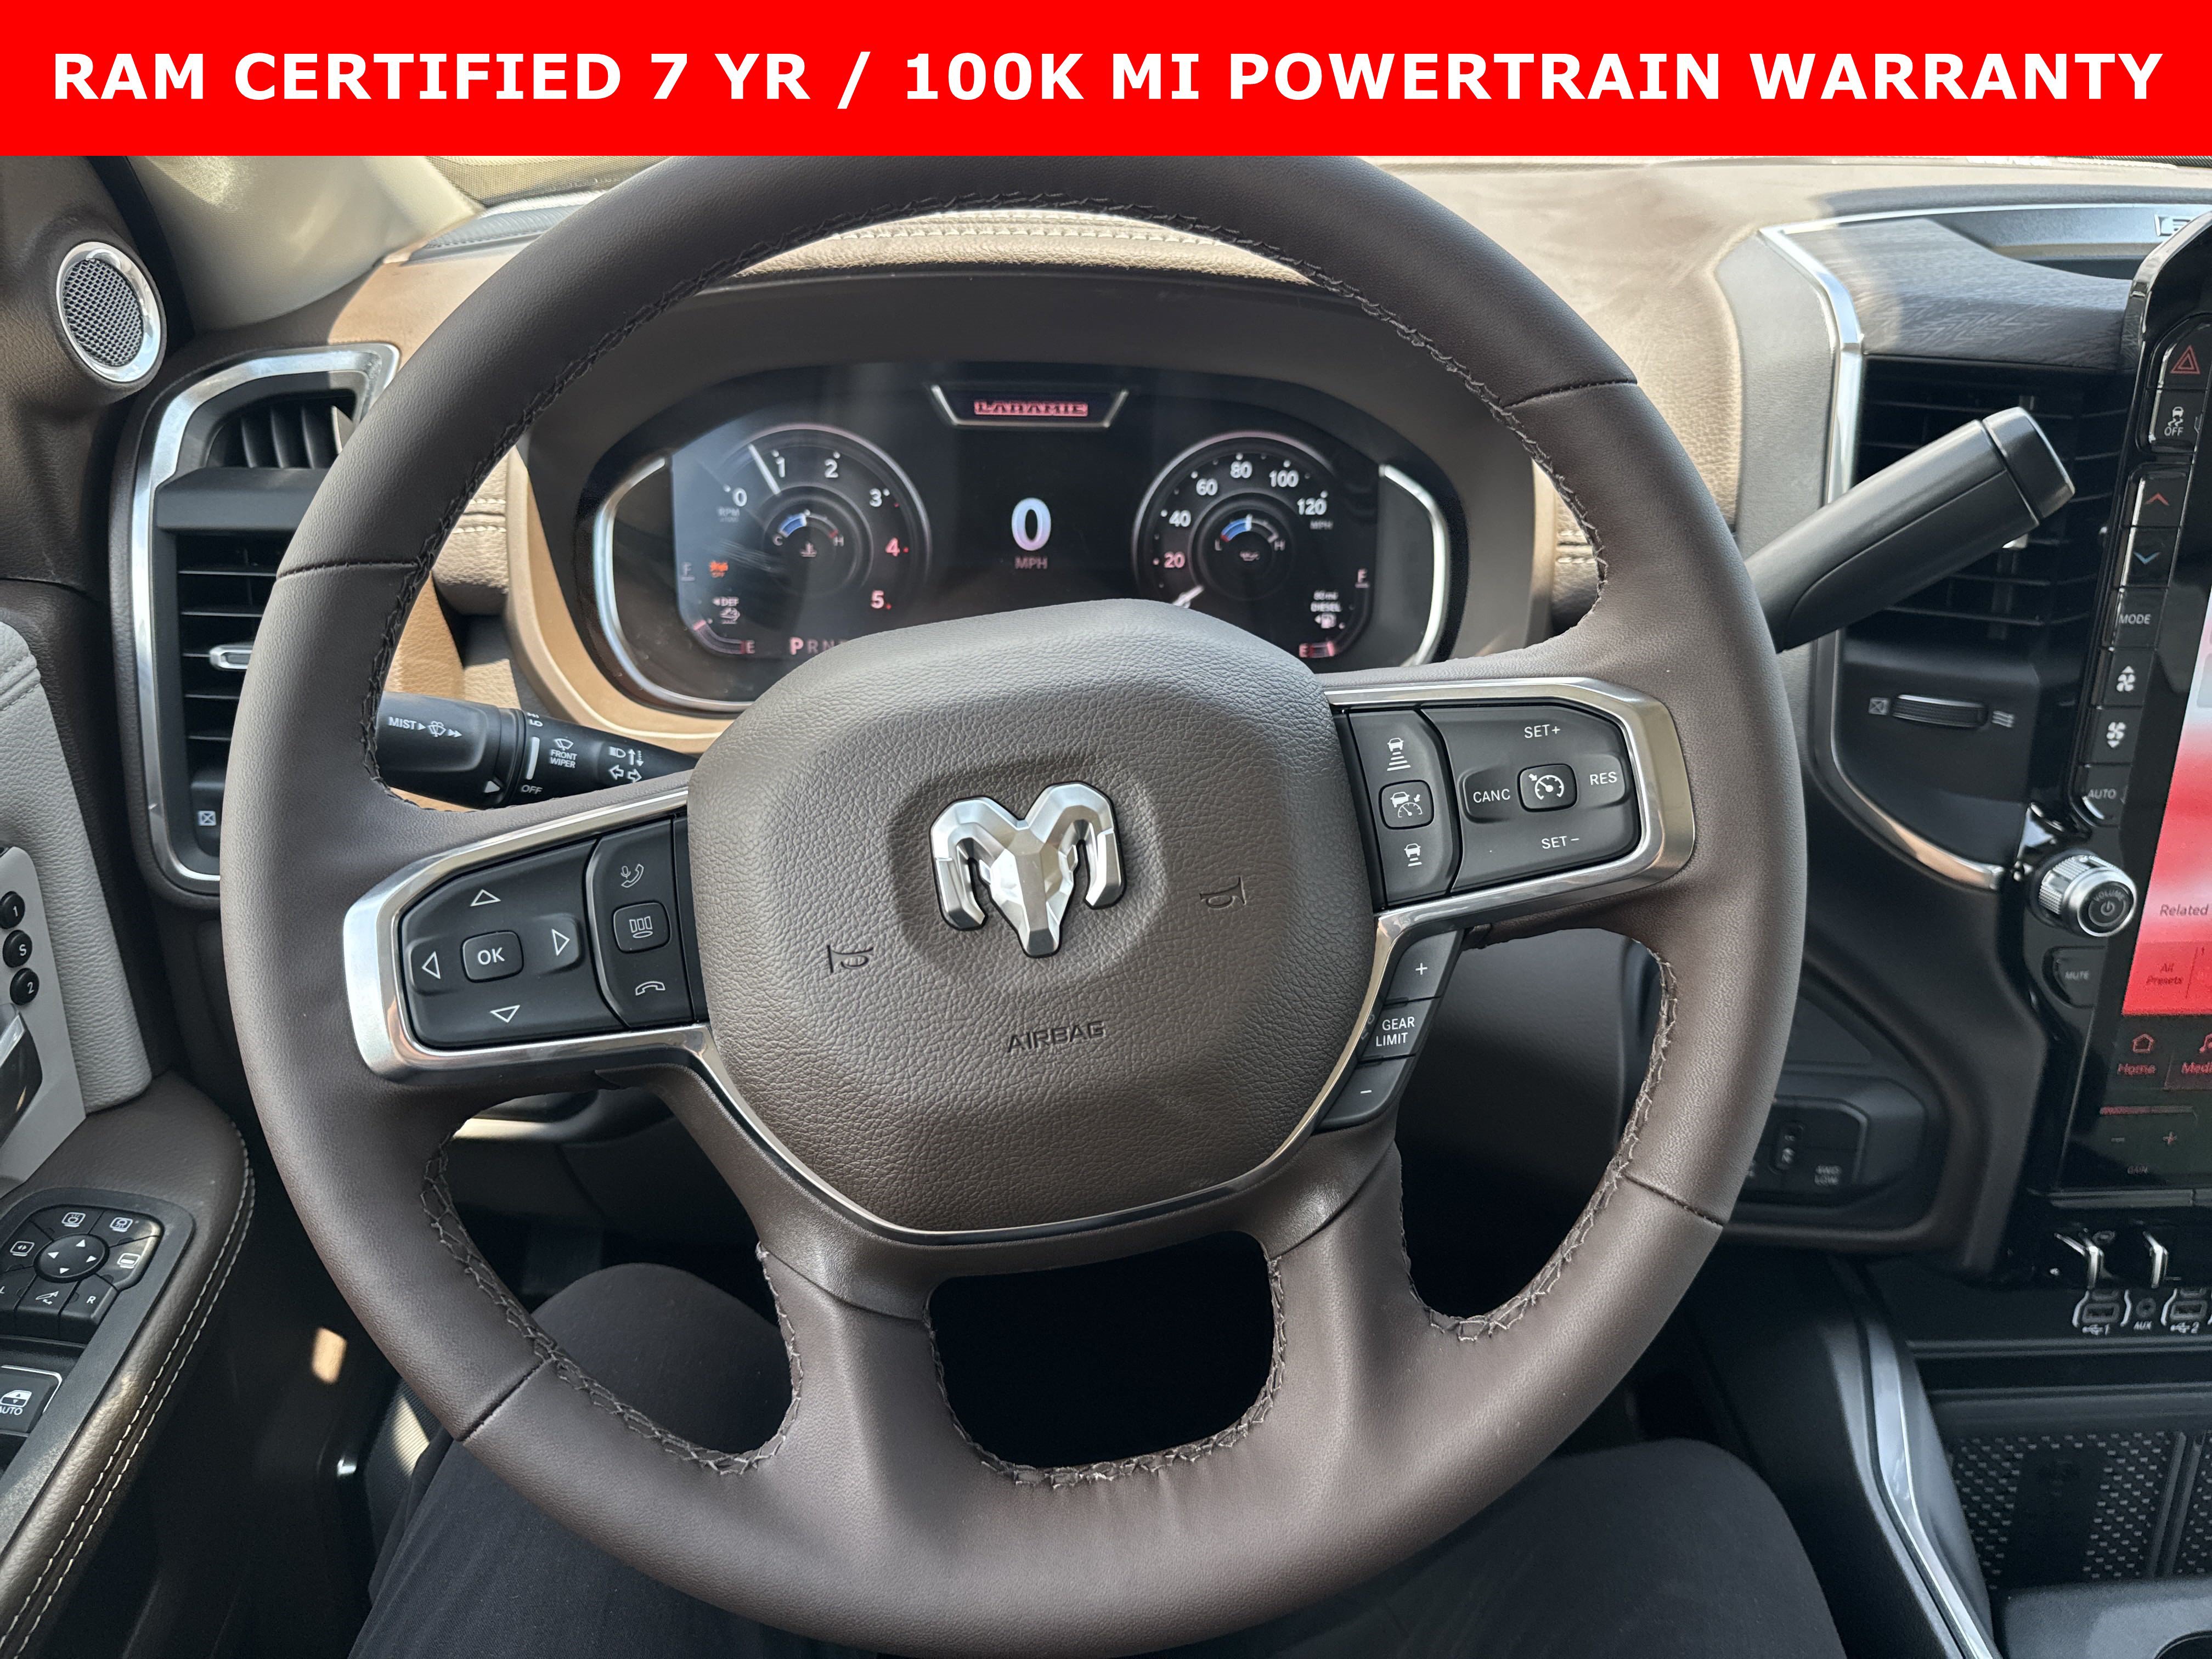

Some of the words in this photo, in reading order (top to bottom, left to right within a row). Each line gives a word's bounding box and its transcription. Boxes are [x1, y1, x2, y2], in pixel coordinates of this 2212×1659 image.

[974, 400, 1088, 417] LARAMIE
[2164, 426, 2184, 437] OFF
[776, 456, 786, 478] 1
[824, 459, 839, 478] 2
[1230, 460, 1252, 478] 80
[1269, 470, 1300, 488] 100
[1196, 478, 1218, 496] 60
[732, 487, 748, 507] 0
[869, 488, 883, 507] 3
[1296, 498, 1328, 516] 120
[1011, 496, 1052, 552] 0
[1169, 510, 1192, 528] 40
[772, 535, 784, 546] C
[833, 535, 844, 547] H
[885, 537, 900, 557] 4
[1014, 556, 1048, 569] MPH
[1163, 552, 1186, 569] 20
[871, 590, 885, 609] 5
[2118, 614, 2151, 625] MODE
[388, 716, 417, 730] MIST
[550, 749, 577, 761] FRONT
[549, 757, 576, 769] WIPER
[1589, 771, 1618, 786] RES
[521, 784, 543, 795] OFF
[1472, 788, 1511, 804] CANC
[2087, 788, 2117, 799] AUTO
[2093, 889, 2125, 902] VOLUME
[13, 905, 18, 917] 1
[2159, 904, 2209, 917] Related
[19, 944, 26, 956] S
[477, 947, 505, 966] OK
[2064, 970, 2090, 980] MUTE
[27, 982, 34, 994] 2
[1381, 1016, 1415, 1031] GEAR
[1007, 1020, 1107, 1053] AIRBAG
[1375, 1032, 1409, 1047] LIMIT
[2117, 1063, 2156, 1075] Home
[86, 1295, 96, 1304] R
[2133, 1321, 2153, 1330] AUX
[2191, 1321, 2199, 1334] 2
